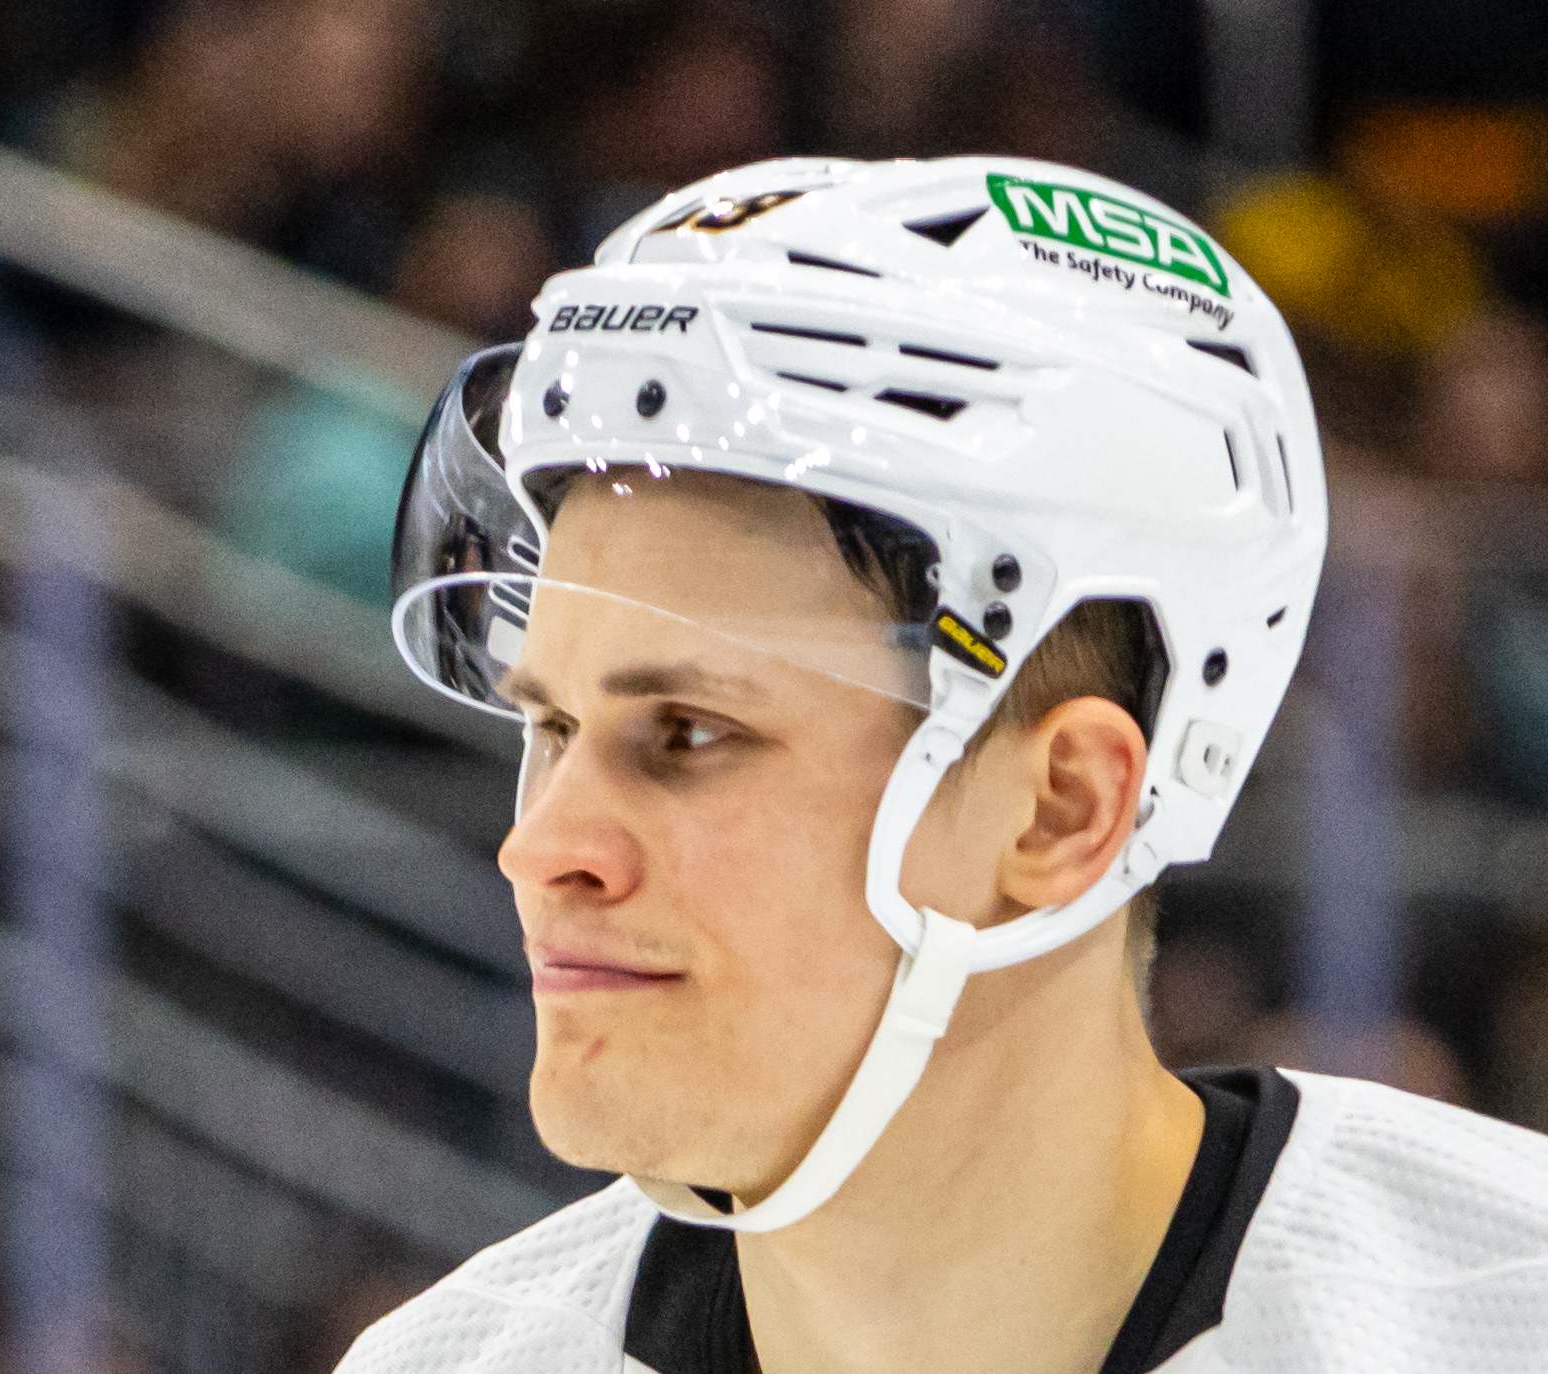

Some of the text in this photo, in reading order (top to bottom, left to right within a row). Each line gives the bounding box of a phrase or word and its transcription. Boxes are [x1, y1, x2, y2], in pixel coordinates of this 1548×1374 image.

[1003, 184, 1224, 288] MSA
[1018, 239, 1060, 265] The
[1066, 251, 1135, 289] Safety
[549, 304, 700, 333] BAUER
